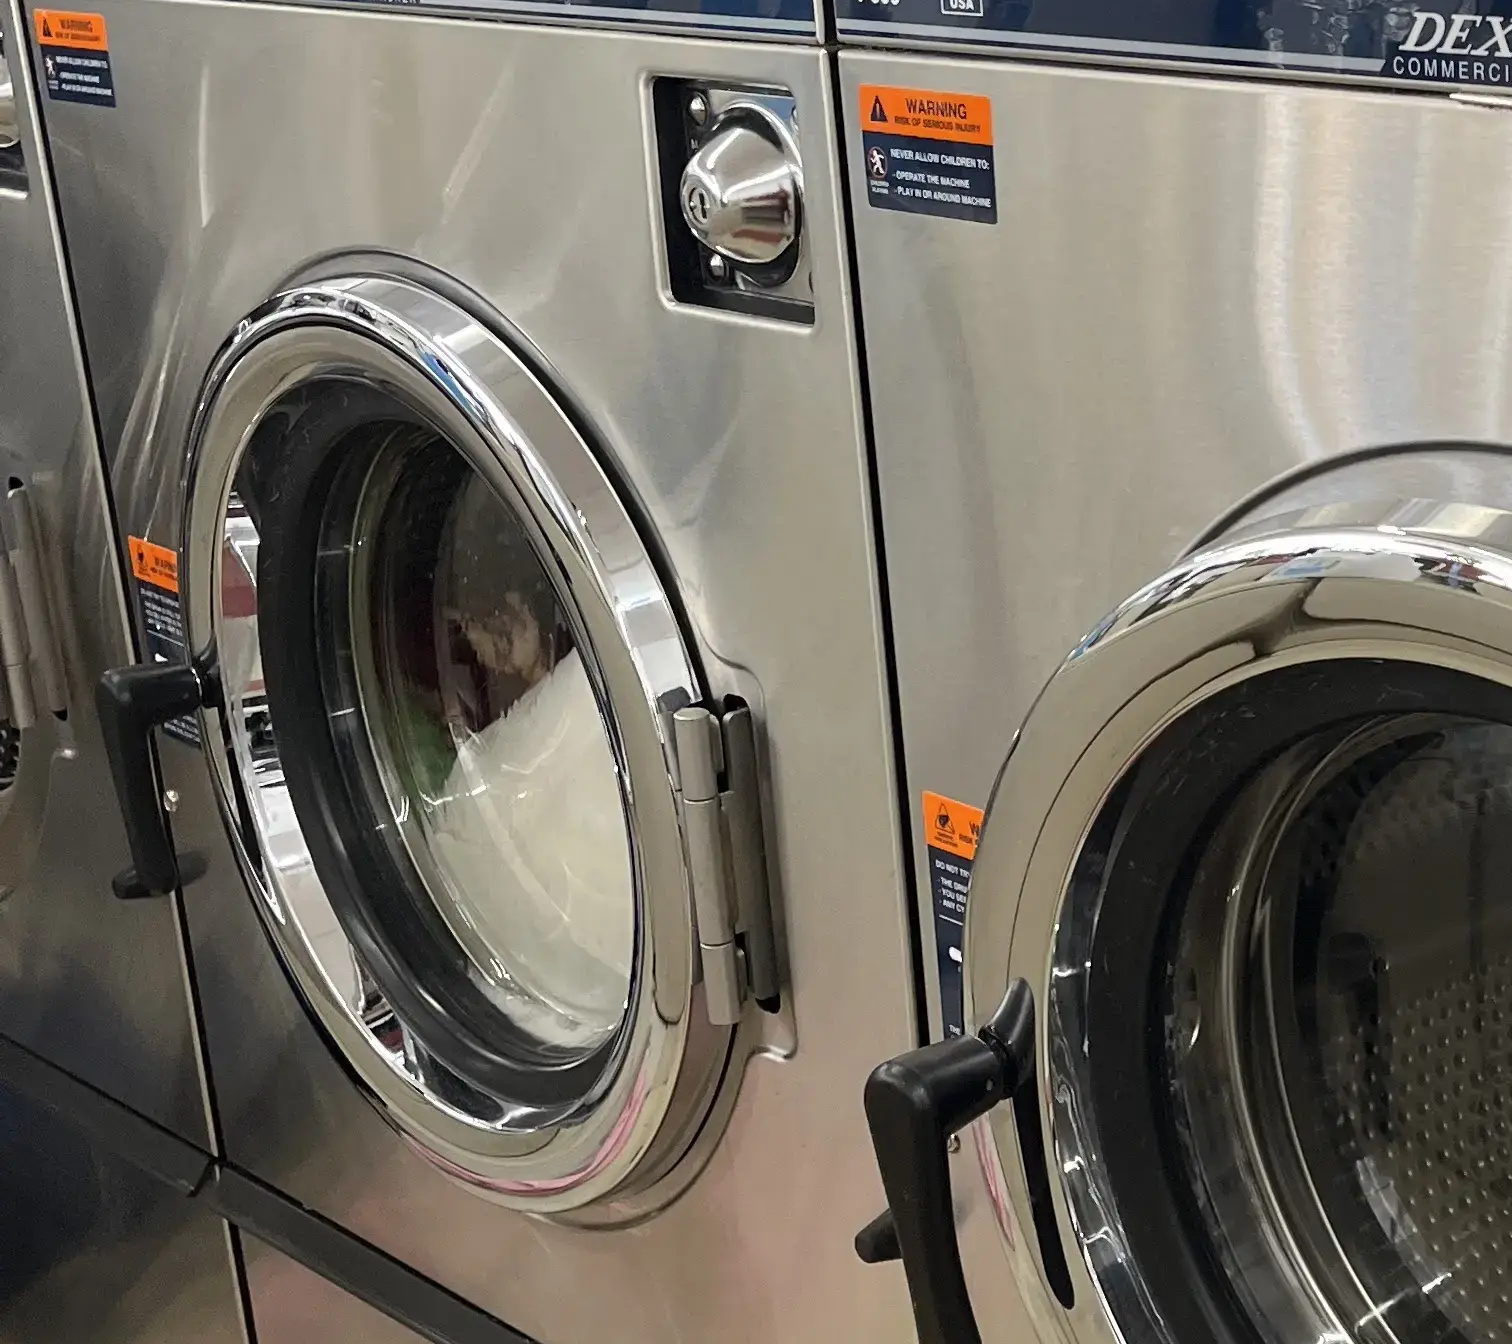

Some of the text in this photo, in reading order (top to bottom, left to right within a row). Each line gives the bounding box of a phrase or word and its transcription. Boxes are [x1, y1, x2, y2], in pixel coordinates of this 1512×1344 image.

[905, 98, 967, 120] WARNING
[890, 148, 914, 161] NEVER
[914, 151, 940, 164] ALLOW
[940, 154, 976, 169] CHILDREN
[926, 174, 940, 185] THE
[961, 194, 992, 208] MACHINE
